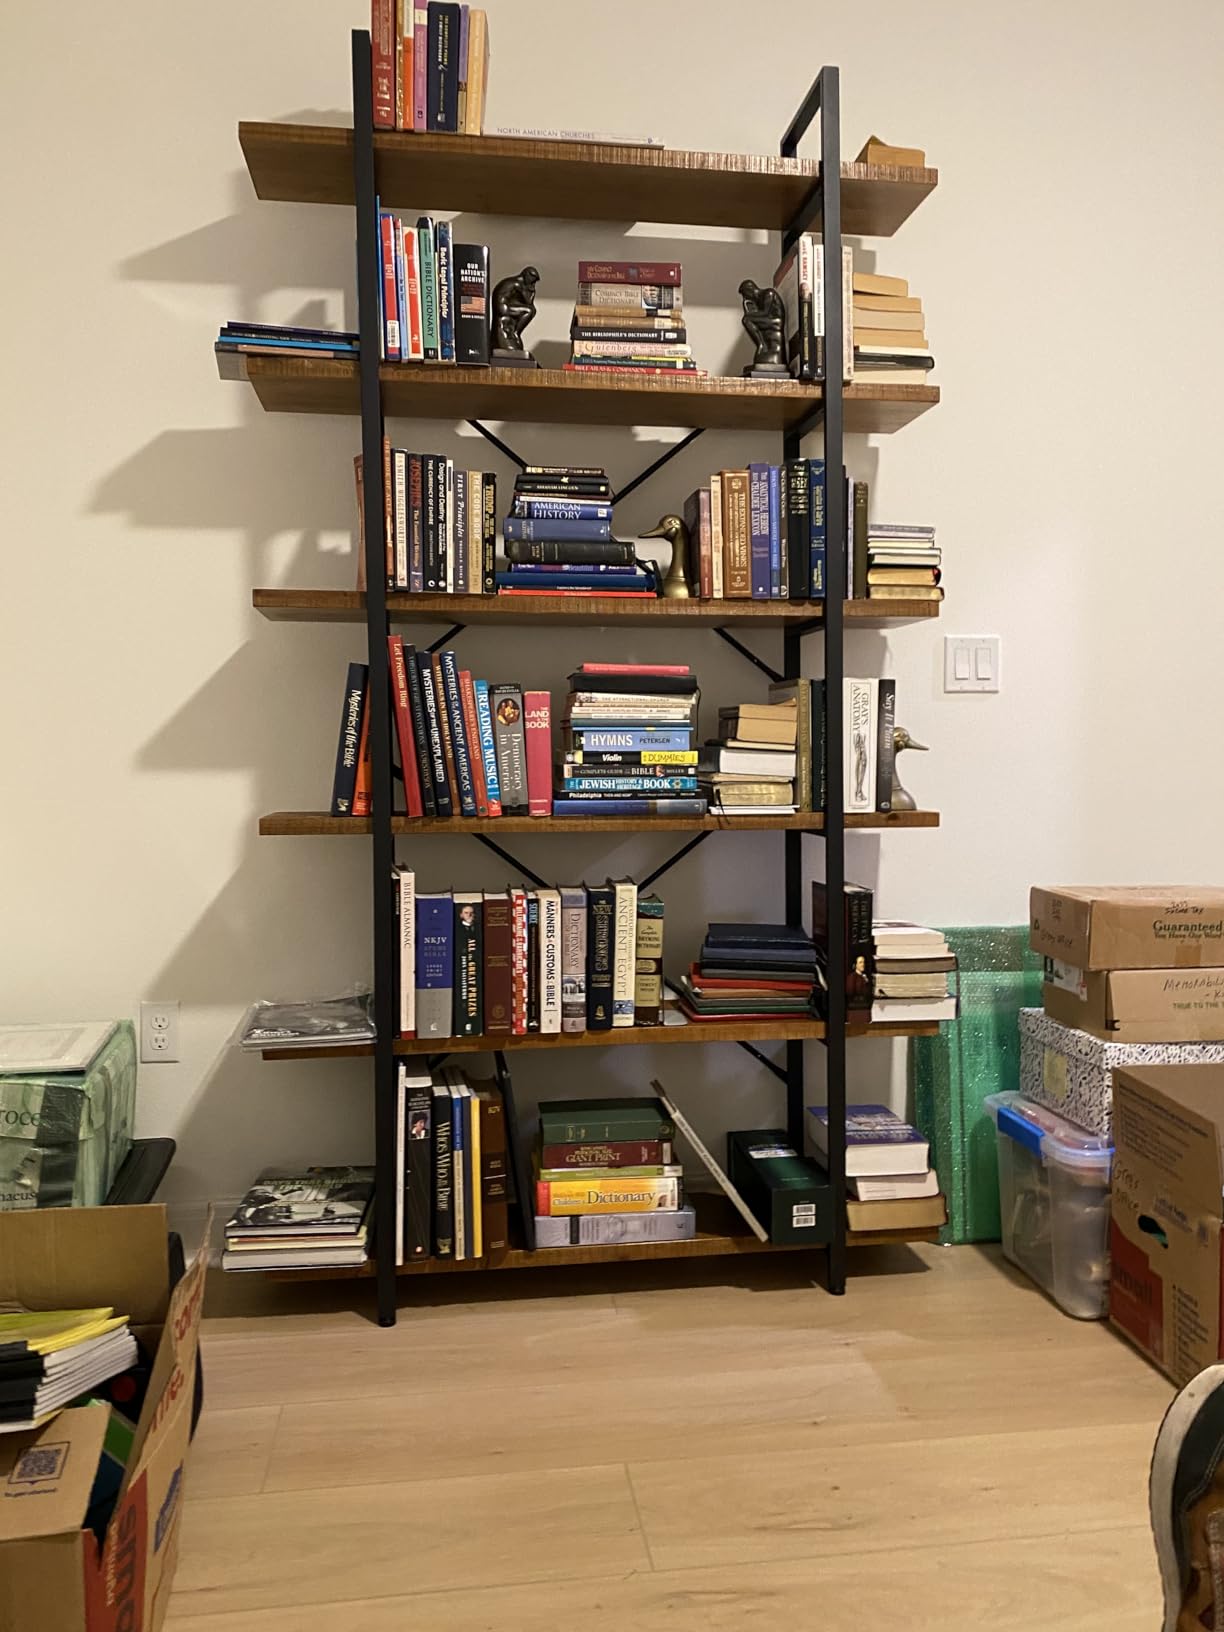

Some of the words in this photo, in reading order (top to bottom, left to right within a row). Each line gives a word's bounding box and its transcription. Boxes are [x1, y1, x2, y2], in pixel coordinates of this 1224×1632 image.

[522, 129, 558, 137] AMERICAN
[560, 130, 595, 139] CHURCHES
[440, 266, 448, 285] Legal
[461, 269, 485, 277] NATION'S
[425, 285, 433, 338] DICTIONARY
[441, 286, 451, 318] Principles
[585, 342, 637, 353] Gutenberg
[410, 459, 421, 507] JOSEPHUS
[751, 481, 759, 508] CHALDEE
[485, 485, 494, 514] TRUMP
[534, 502, 580, 511] AMERICAN
[760, 481, 768, 512] ANALYTICAL
[397, 489, 405, 544] WIGGLESWORTH
[437, 499, 445, 521] Destiny
[456, 501, 464, 538] Principles
[534, 510, 582, 519] HISTORY
[752, 510, 760, 536] LEXICON
[760, 513, 769, 535] HEBREW
[394, 643, 404, 655] Let
[396, 657, 405, 689] Freedom
[444, 656, 457, 700] MYSTERIES
[347, 690, 362, 726] Mysteries
[399, 690, 407, 708] Ring
[439, 701, 446, 709] IN
[852, 685, 861, 731] ANATOMY
[861, 693, 869, 725] GRAY'S
[882, 693, 894, 710] Say
[464, 679, 476, 727] SHAKESPEARE'S
[470, 727, 480, 759] ENGLAND
[478, 691, 493, 749] READING
[525, 710, 549, 718] LAND
[345, 727, 358, 735] of
[421, 669, 435, 713] MYSTERIES
[430, 728, 444, 783] UNEXPLAINED
[442, 723, 450, 740] HOLY
[451, 708, 463, 745] ANCIENT
[884, 721, 894, 749] Plain
[345, 735, 356, 747] the
[444, 741, 453, 758] LAND
[500, 734, 510, 745] in
[591, 735, 633, 746] HYMNS
[343, 748, 356, 767] Bible
[456, 747, 470, 791] AMERICAS
[511, 734, 522, 790] Democracy
[602, 754, 622, 762] Violin
[648, 754, 686, 762] DUMMIES
[501, 749, 510, 791] America
[580, 779, 616, 789] JEWISH
[643, 779, 670, 789] BOOK
[403, 882, 411, 905] BIBLE
[529, 903, 537, 924] SCIENCE
[546, 900, 555, 939] MANNERS
[593, 904, 612, 915] NEW
[403, 907, 412, 949] ALMANAC
[619, 897, 628, 952] ANCIENT
[1152, 920, 1223, 932] Guaranteed
[468, 939, 476, 952] ALL
[570, 913, 581, 969] DICTIONARY
[596, 915, 609, 971] STRONG'S
[546, 943, 555, 980] CUSTOMS
[468, 962, 477, 986] GREAT
[616, 958, 626, 995] EGYPT
[468, 987, 477, 1017] PRIZES
[546, 985, 554, 1006] BIBLE
[437, 1153, 451, 1179] WHO
[566, 1153, 594, 1163] GIANT
[595, 1152, 622, 1162] PRINT
[436, 1187, 451, 1210] BIBLE
[588, 1189, 656, 1204] Dictionary
